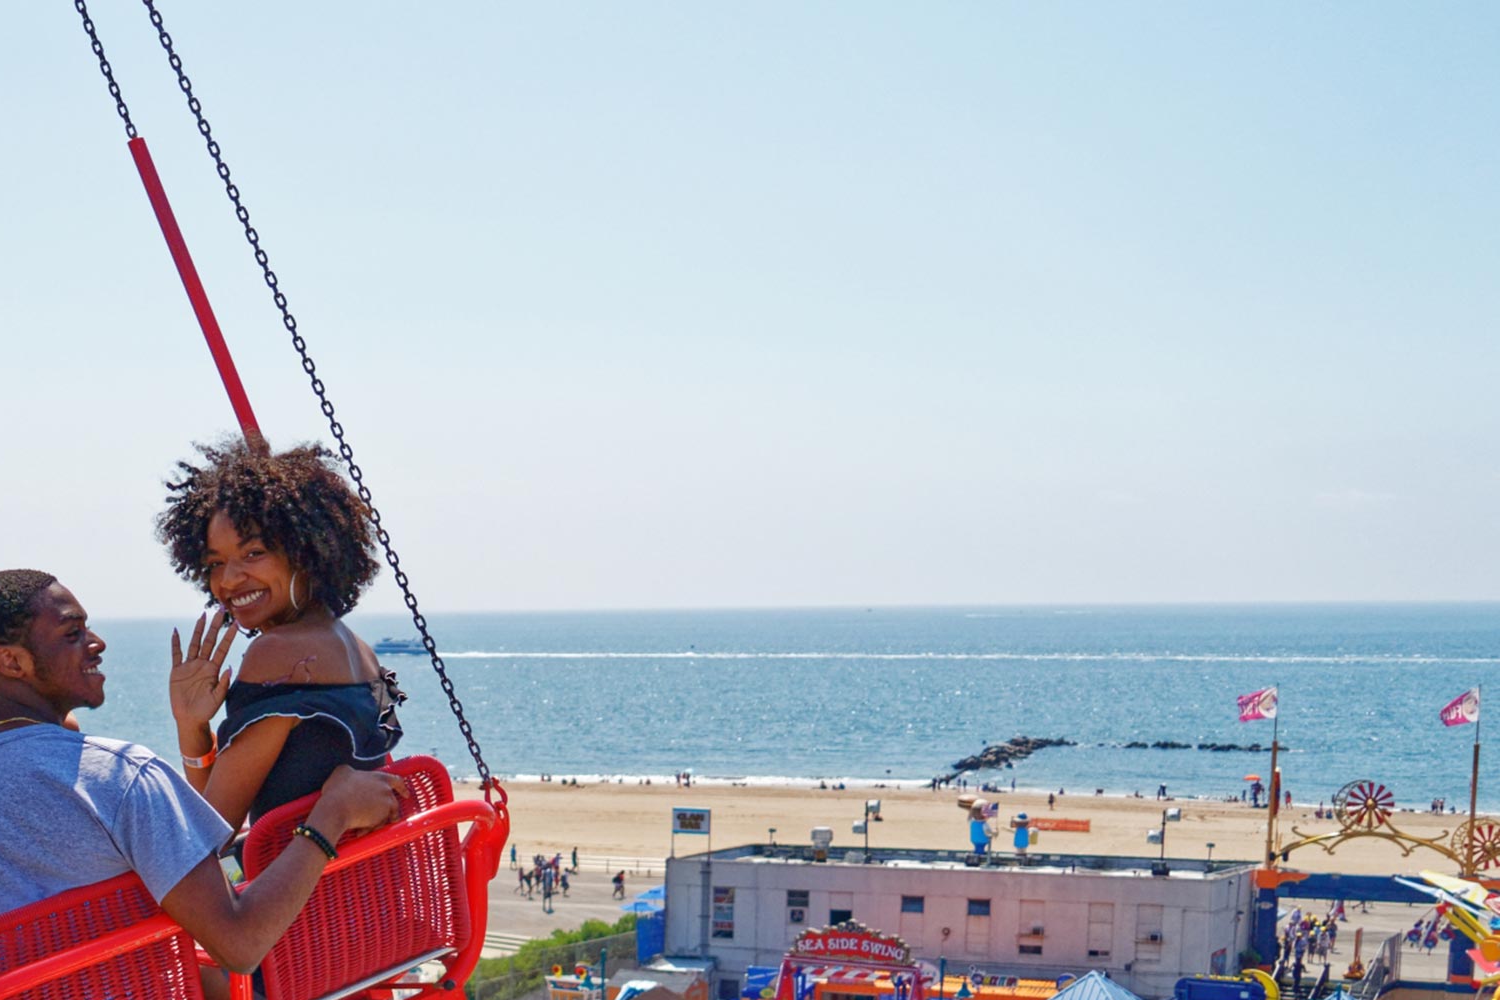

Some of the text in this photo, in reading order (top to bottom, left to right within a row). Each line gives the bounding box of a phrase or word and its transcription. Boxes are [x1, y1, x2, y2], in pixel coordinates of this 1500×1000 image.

[797, 937, 905, 960] SEA SIDE SWING
